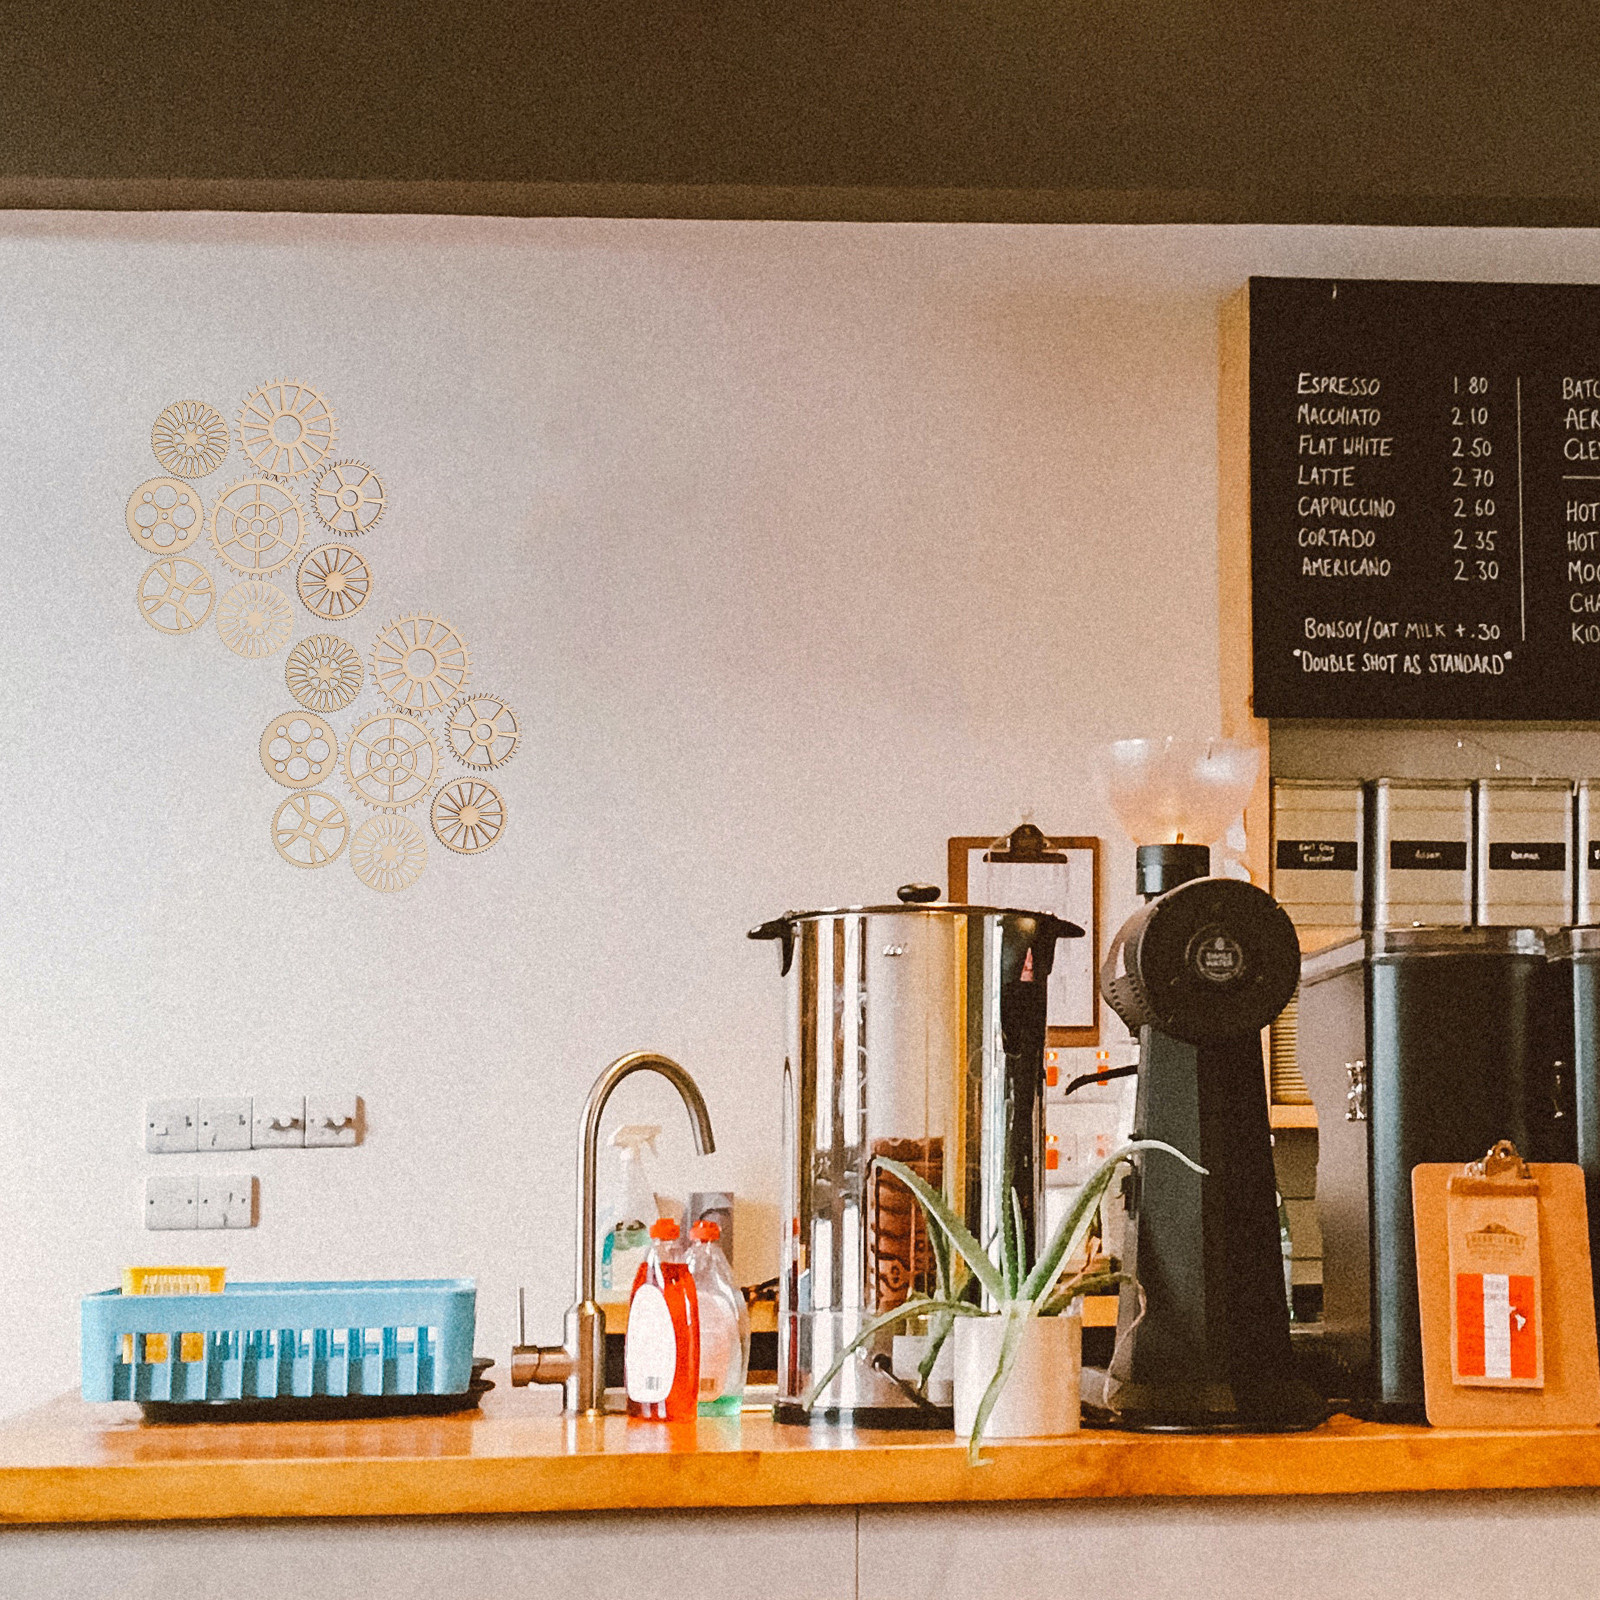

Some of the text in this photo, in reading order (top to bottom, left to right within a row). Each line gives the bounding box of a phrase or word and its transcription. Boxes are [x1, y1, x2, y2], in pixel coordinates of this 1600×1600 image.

[1297, 372, 1380, 396] ESPRESSO
[1297, 402, 1381, 426] MACCHIATO
[1299, 434, 1394, 457] FLAT WHITE
[1297, 464, 1356, 486] LATTE
[1297, 496, 1396, 518] CAPPUCCINO
[1566, 501, 1600, 523] HOT
[1297, 527, 1376, 549] CORTADO
[1566, 531, 1599, 552] HOT
[1302, 556, 1392, 577] AMERICANO
[1404, 622, 1447, 640] MILK
[1361, 652, 1398, 674] SHOT
[1403, 653, 1422, 675] AS
